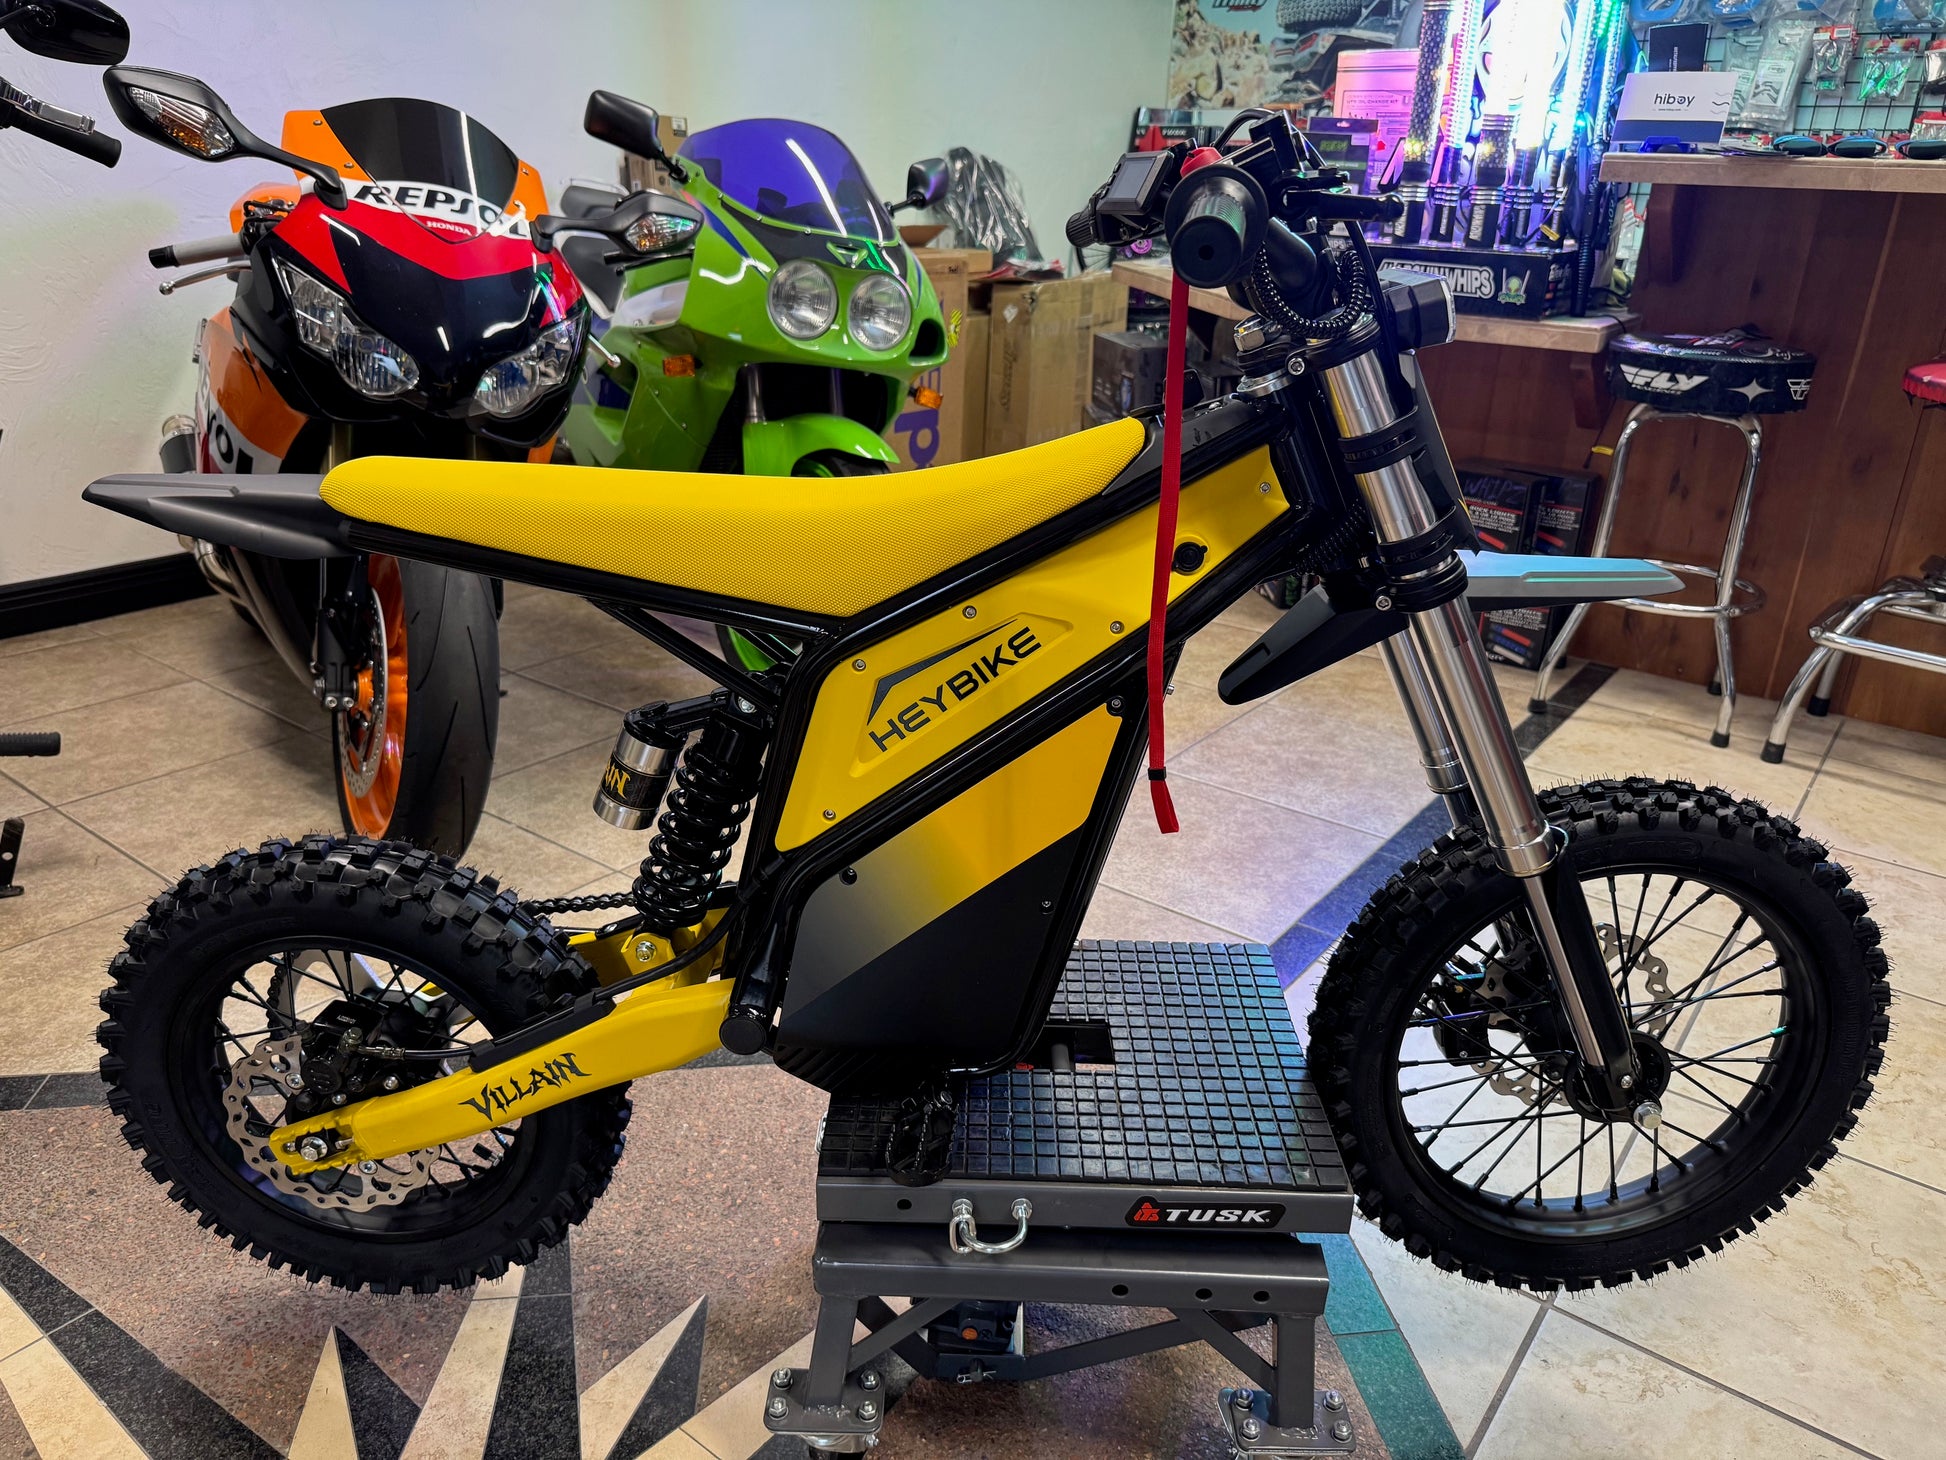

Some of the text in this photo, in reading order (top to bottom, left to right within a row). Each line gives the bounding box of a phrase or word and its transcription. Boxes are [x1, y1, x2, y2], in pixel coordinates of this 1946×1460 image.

[1654, 93, 1695, 108] hiboy
[426, 220, 473, 236] HONDA
[1619, 363, 1710, 391] FLY
[868, 626, 1042, 753] HEYBIKE
[458, 1052, 592, 1122] VILLAIN
[1166, 1209, 1268, 1223] TUSK
